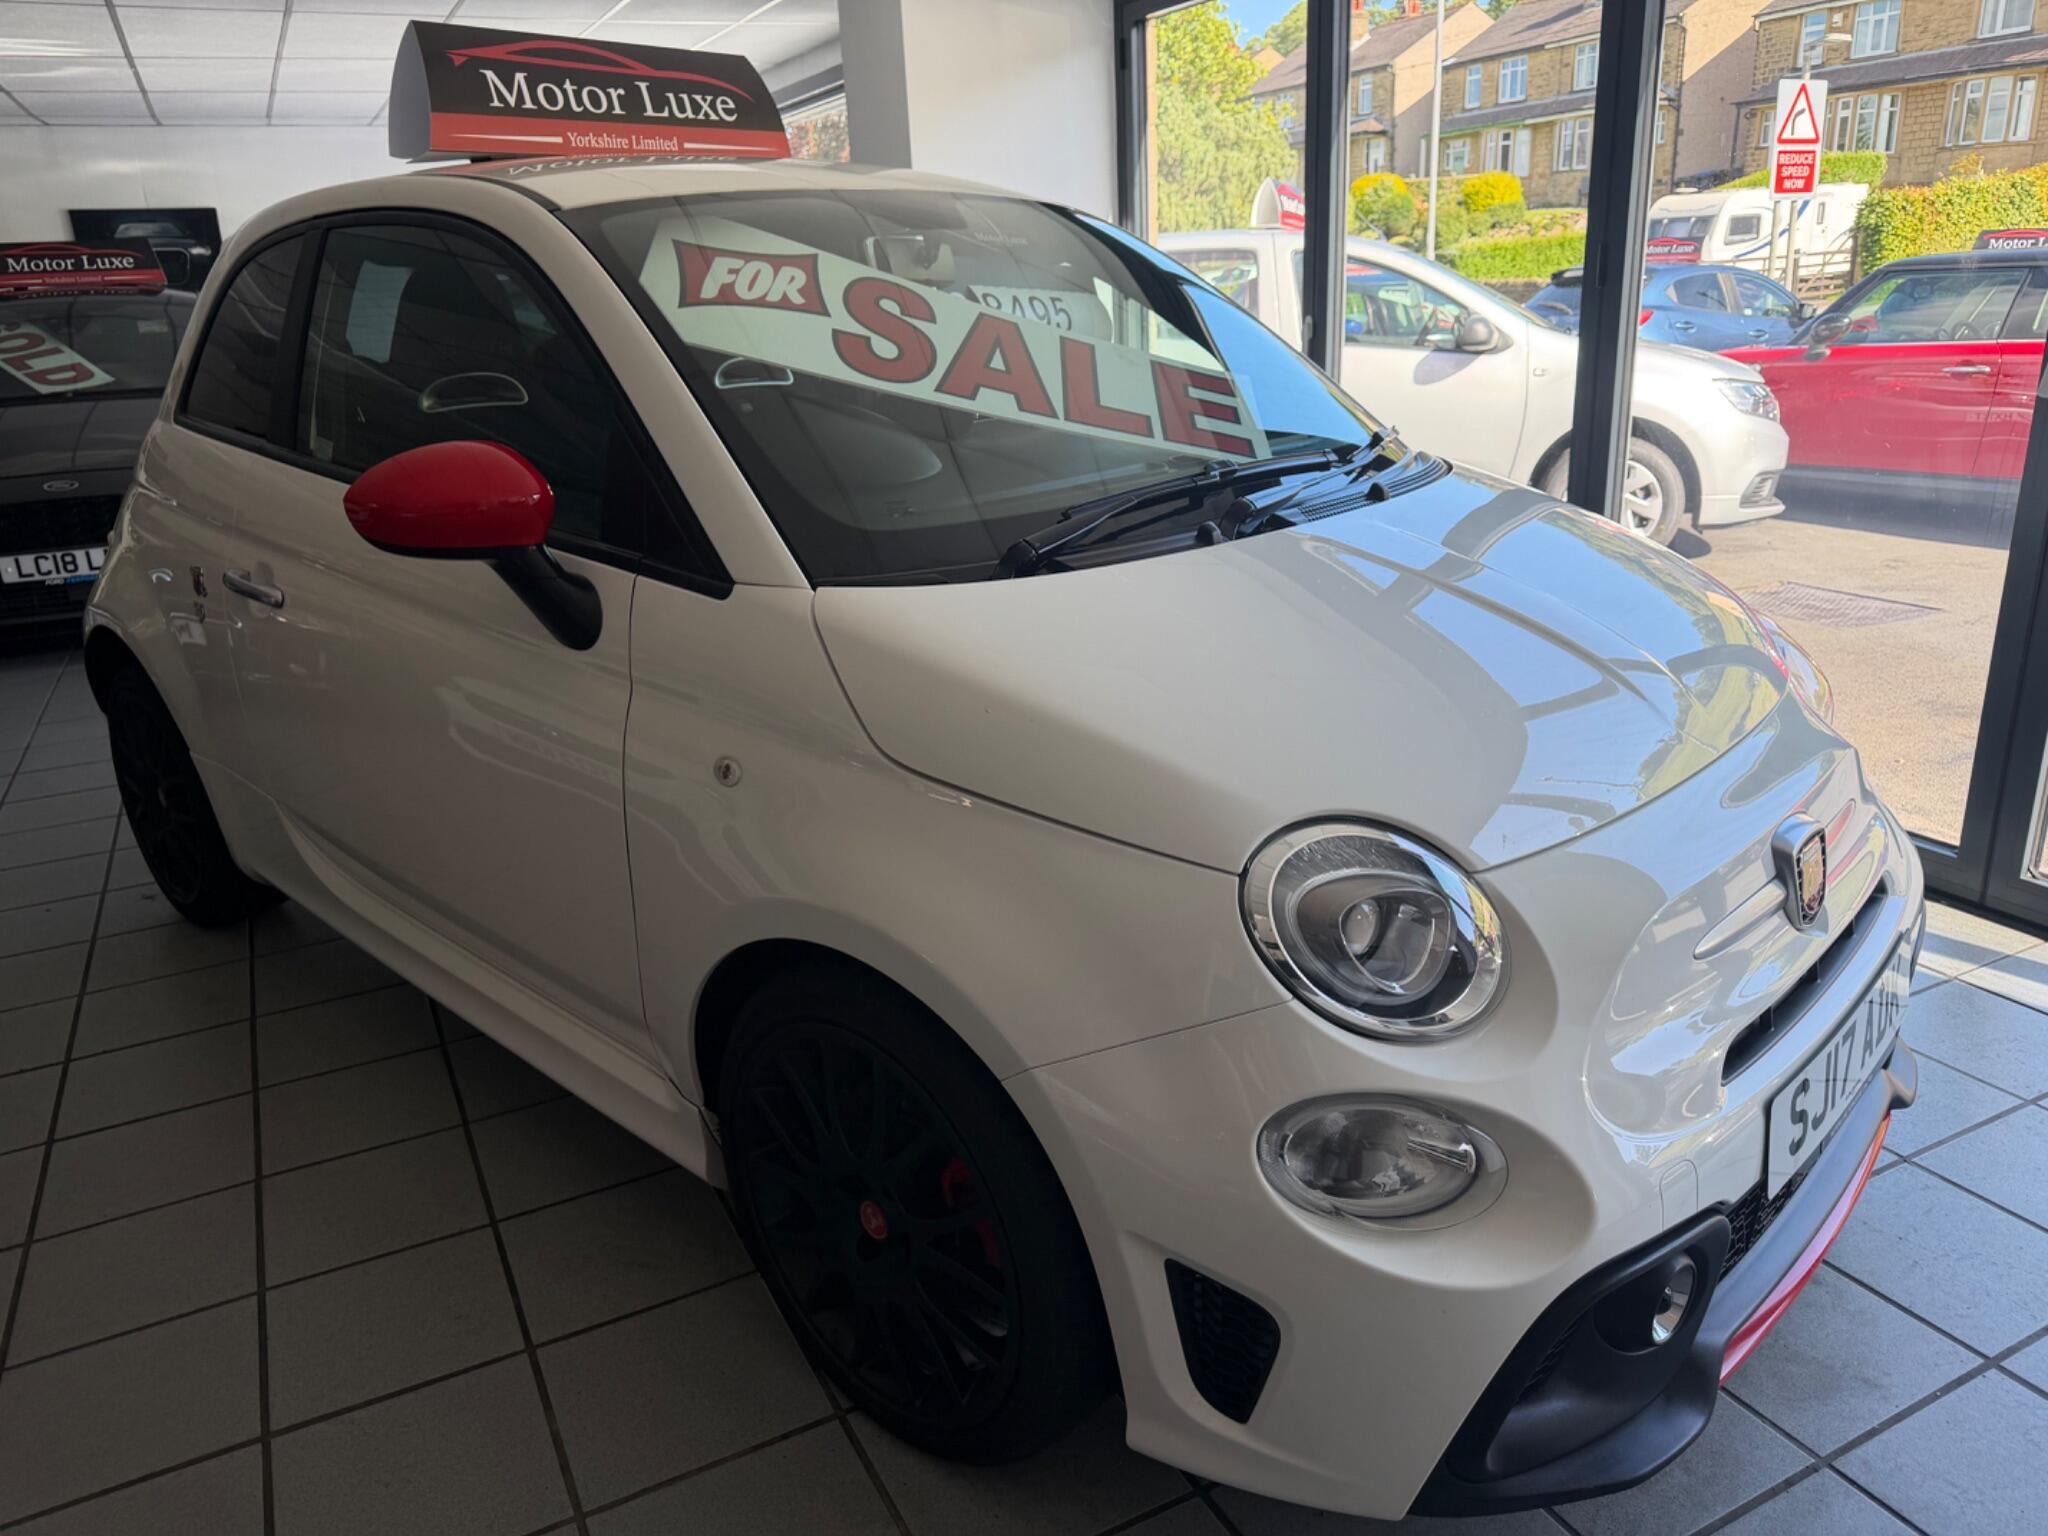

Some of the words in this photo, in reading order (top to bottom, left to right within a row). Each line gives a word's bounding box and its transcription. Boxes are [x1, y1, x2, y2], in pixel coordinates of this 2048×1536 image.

[480, 69, 625, 115] Motor
[634, 81, 738, 122] Luxe
[567, 132, 629, 149] Yorkshire
[632, 134, 678, 151] Limited
[1778, 153, 1815, 164] REDUCE
[1781, 166, 1810, 177] SPEED
[1783, 179, 1806, 189] NOW
[1647, 245, 1671, 254] otor
[1988, 237, 2035, 250] Motor
[6, 256, 75, 272] Motor
[81, 254, 135, 270] Luxe
[0, 322, 95, 386] OLD
[699, 256, 808, 304] FOR
[831, 276, 1257, 459] SALE
[14, 553, 79, 579] LC18
[1788, 1018, 1857, 1157] SJ17
